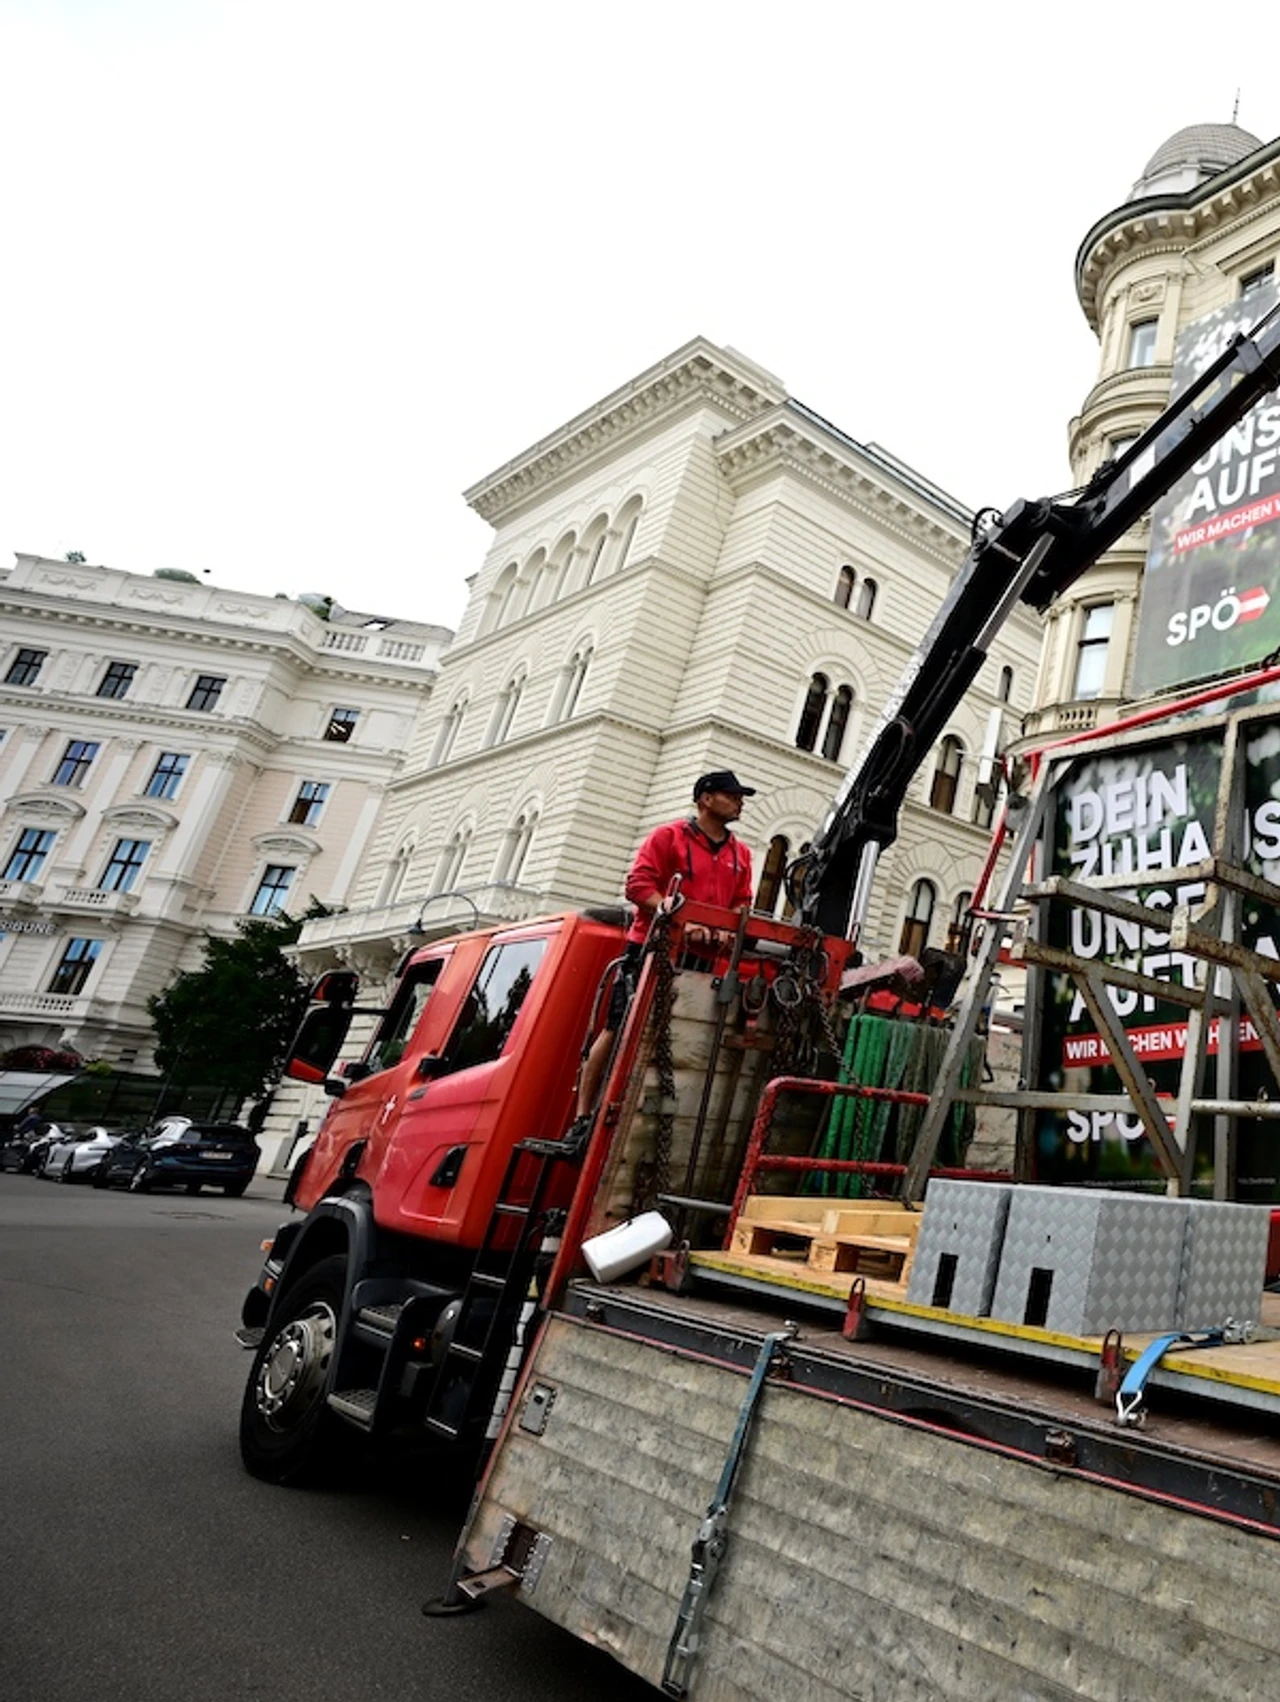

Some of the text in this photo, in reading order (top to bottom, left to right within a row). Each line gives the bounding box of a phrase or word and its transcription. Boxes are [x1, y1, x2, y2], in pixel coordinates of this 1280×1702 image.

[1176, 529, 1206, 549] WIR
[1207, 502, 1273, 538] MACHEN
[1165, 587, 1241, 647] SPÖ
[1071, 763, 1188, 844] DEIN
[1066, 1039, 1098, 1060] WIR
